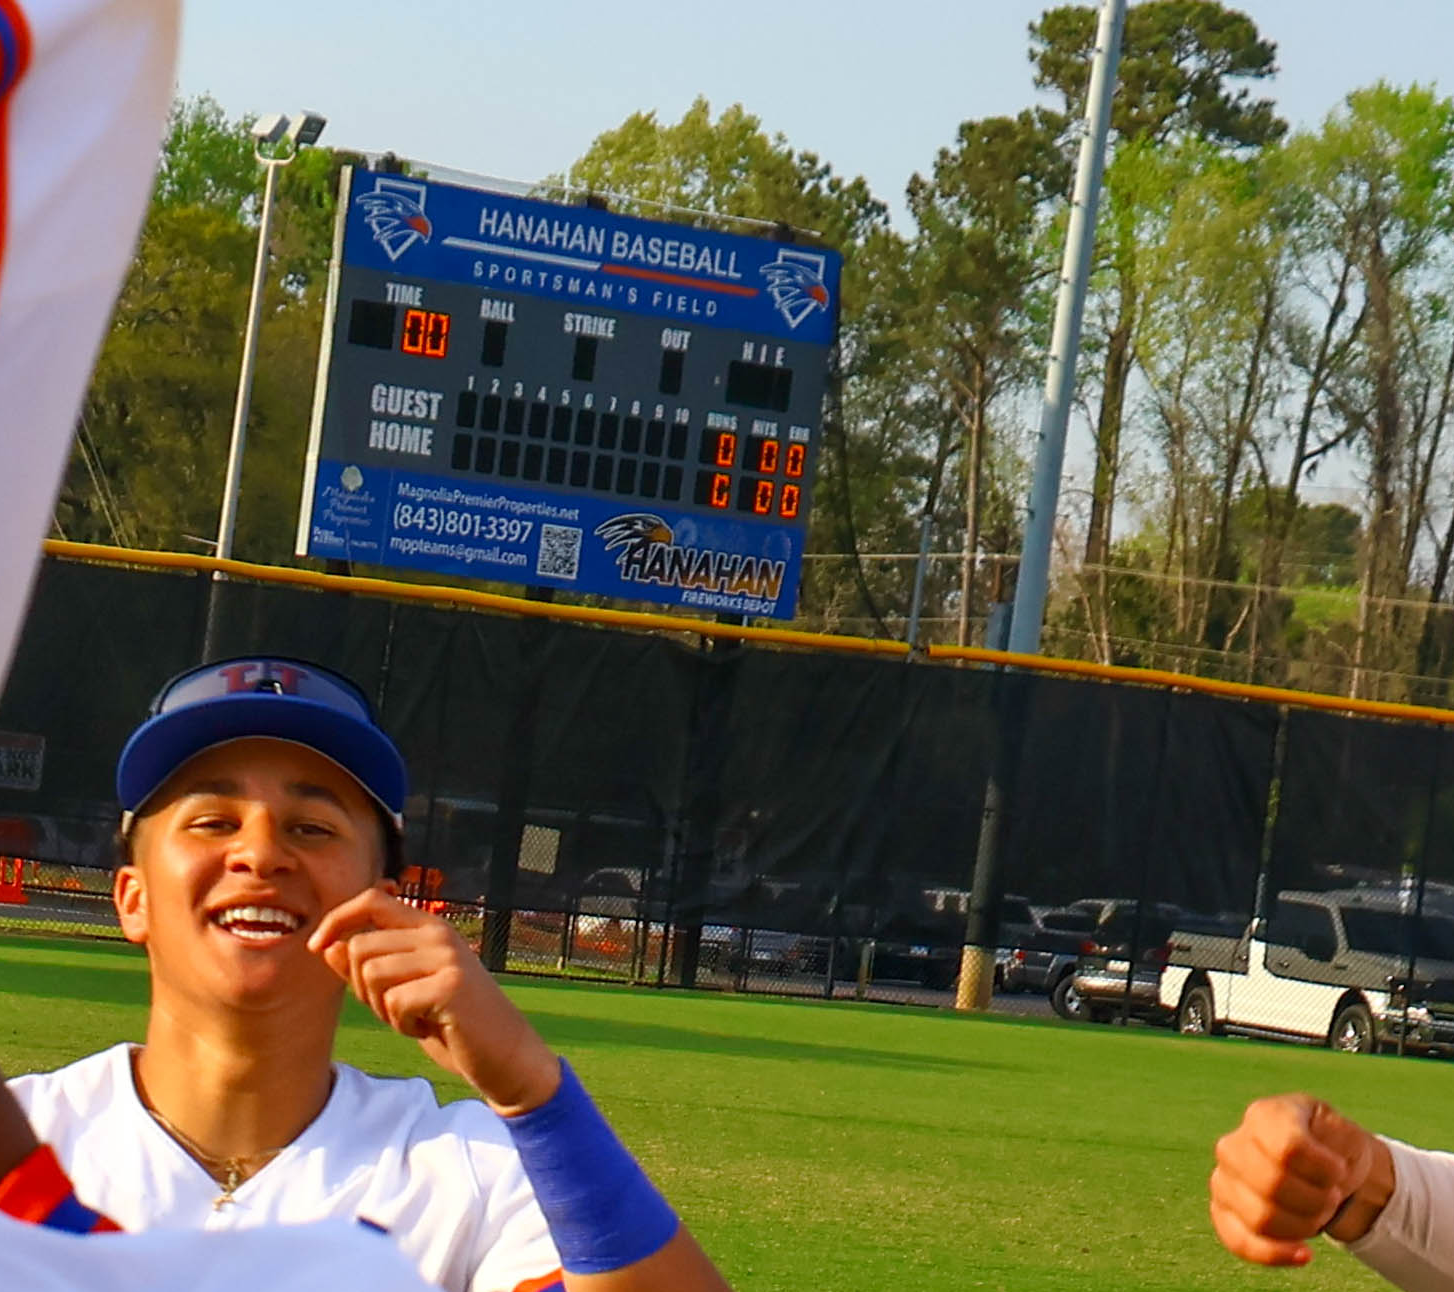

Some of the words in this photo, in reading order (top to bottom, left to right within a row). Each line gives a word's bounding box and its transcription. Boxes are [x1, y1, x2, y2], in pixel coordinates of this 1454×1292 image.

[479, 206, 606, 255] HANAHAN
[610, 230, 742, 280] BASEBALL
[386, 282, 423, 307] TIME
[474, 261, 638, 304] SPORTSMAN'S
[652, 292, 718, 317] FIELD
[480, 299, 515, 323] BALL
[564, 312, 617, 339] STRIKE
[660, 327, 692, 351] OUT
[370, 383, 443, 421] GUEST
[467, 376, 476, 391] 1
[492, 379, 501, 395] 2
[514, 382, 523, 398] 3
[538, 386, 547, 403] 4
[562, 389, 570, 406] 5
[585, 393, 593, 409] 6
[610, 396, 618, 412] 7
[675, 407, 690, 424] 10
[368, 419, 434, 456] HOME
[397, 482, 580, 521] MagnoliaPremierProperties.net
[393, 502, 533, 544] (843)801-3397
[390, 536, 528, 566] mppteams@gmail.com
[620, 541, 786, 600] HANAHAN
